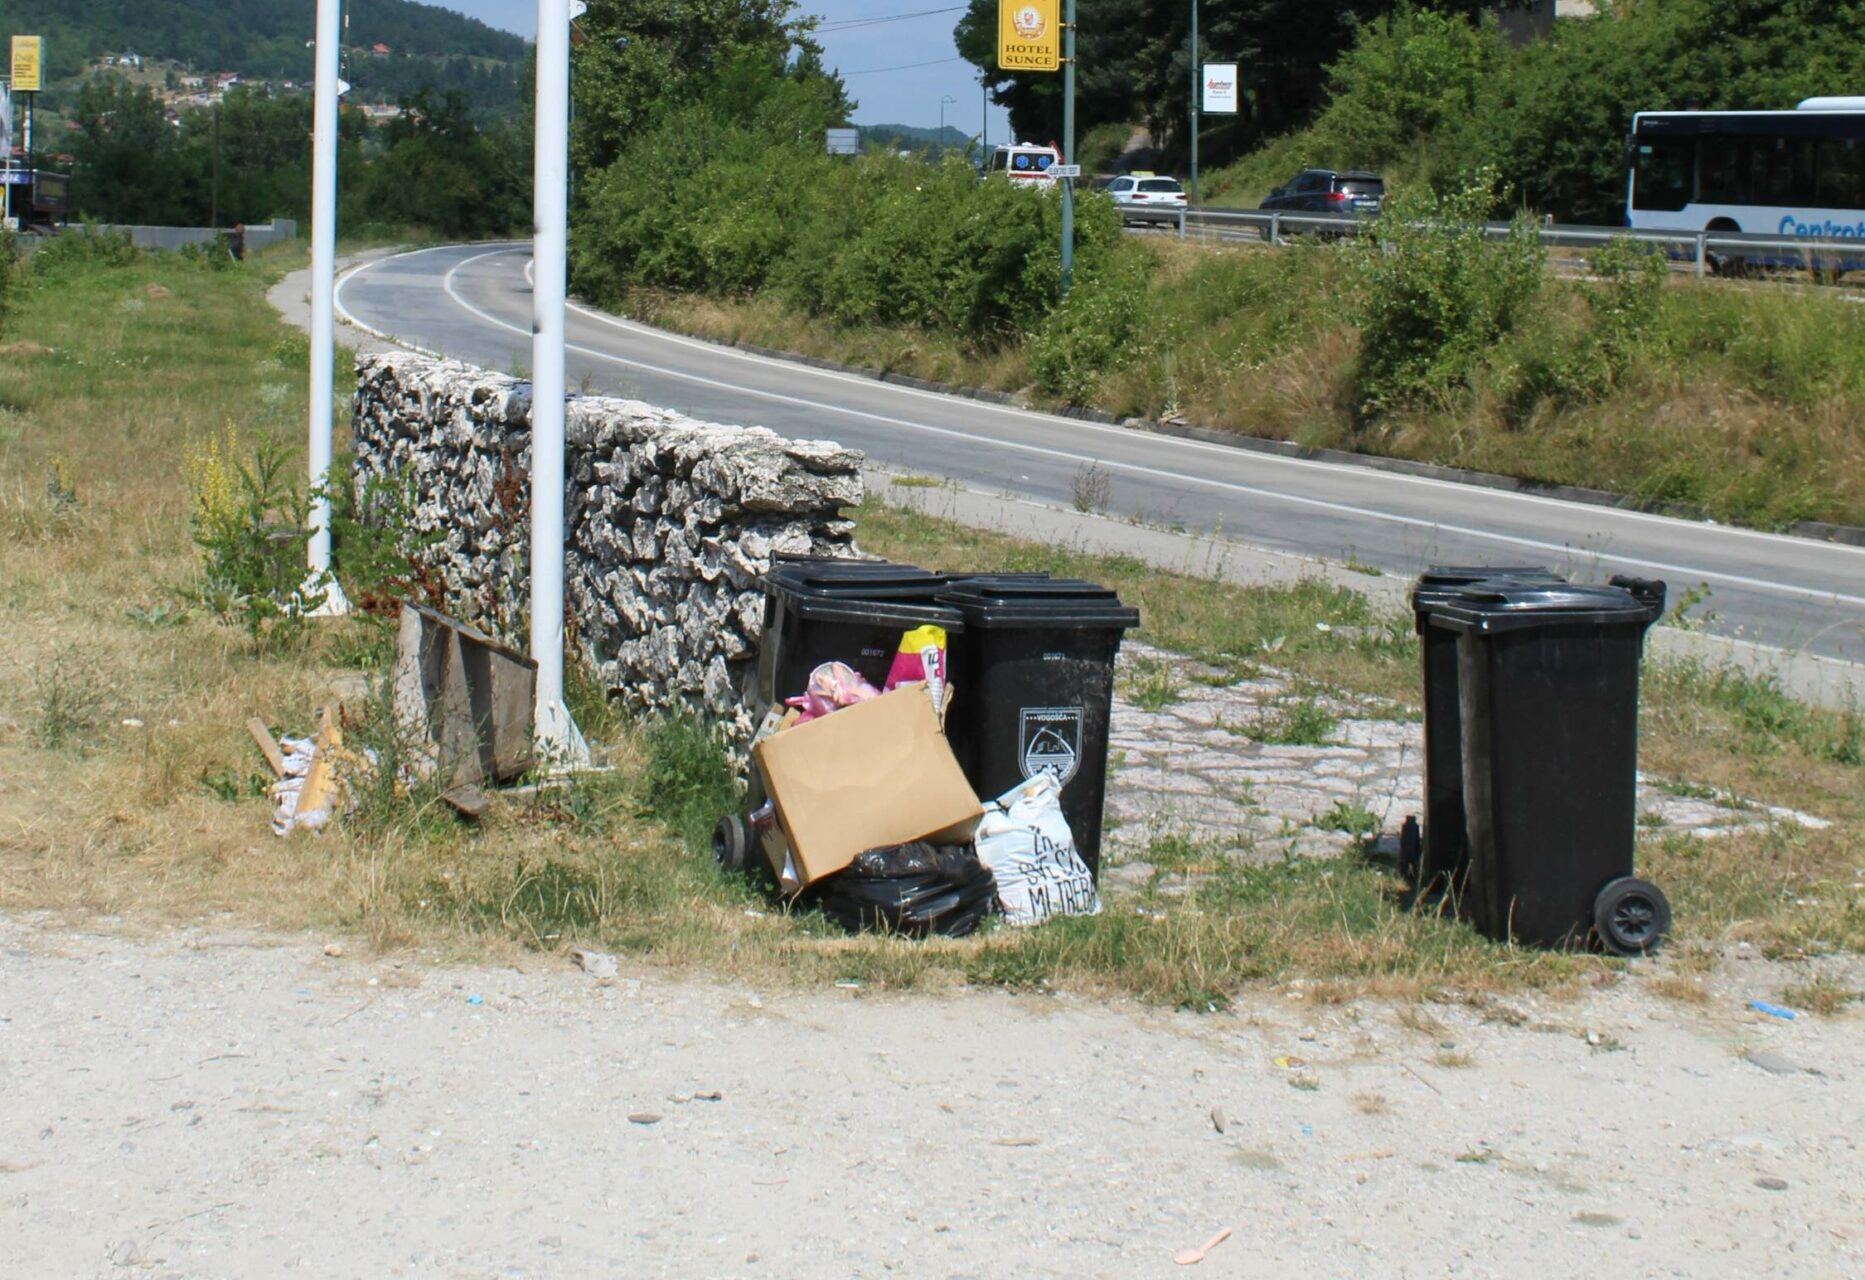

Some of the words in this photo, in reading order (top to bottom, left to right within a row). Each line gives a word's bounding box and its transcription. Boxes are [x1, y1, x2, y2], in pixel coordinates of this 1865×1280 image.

[1006, 44, 1052, 55] HOTEL
[1006, 55, 1052, 65] SUNCE
[1028, 884, 1052, 918] MI
